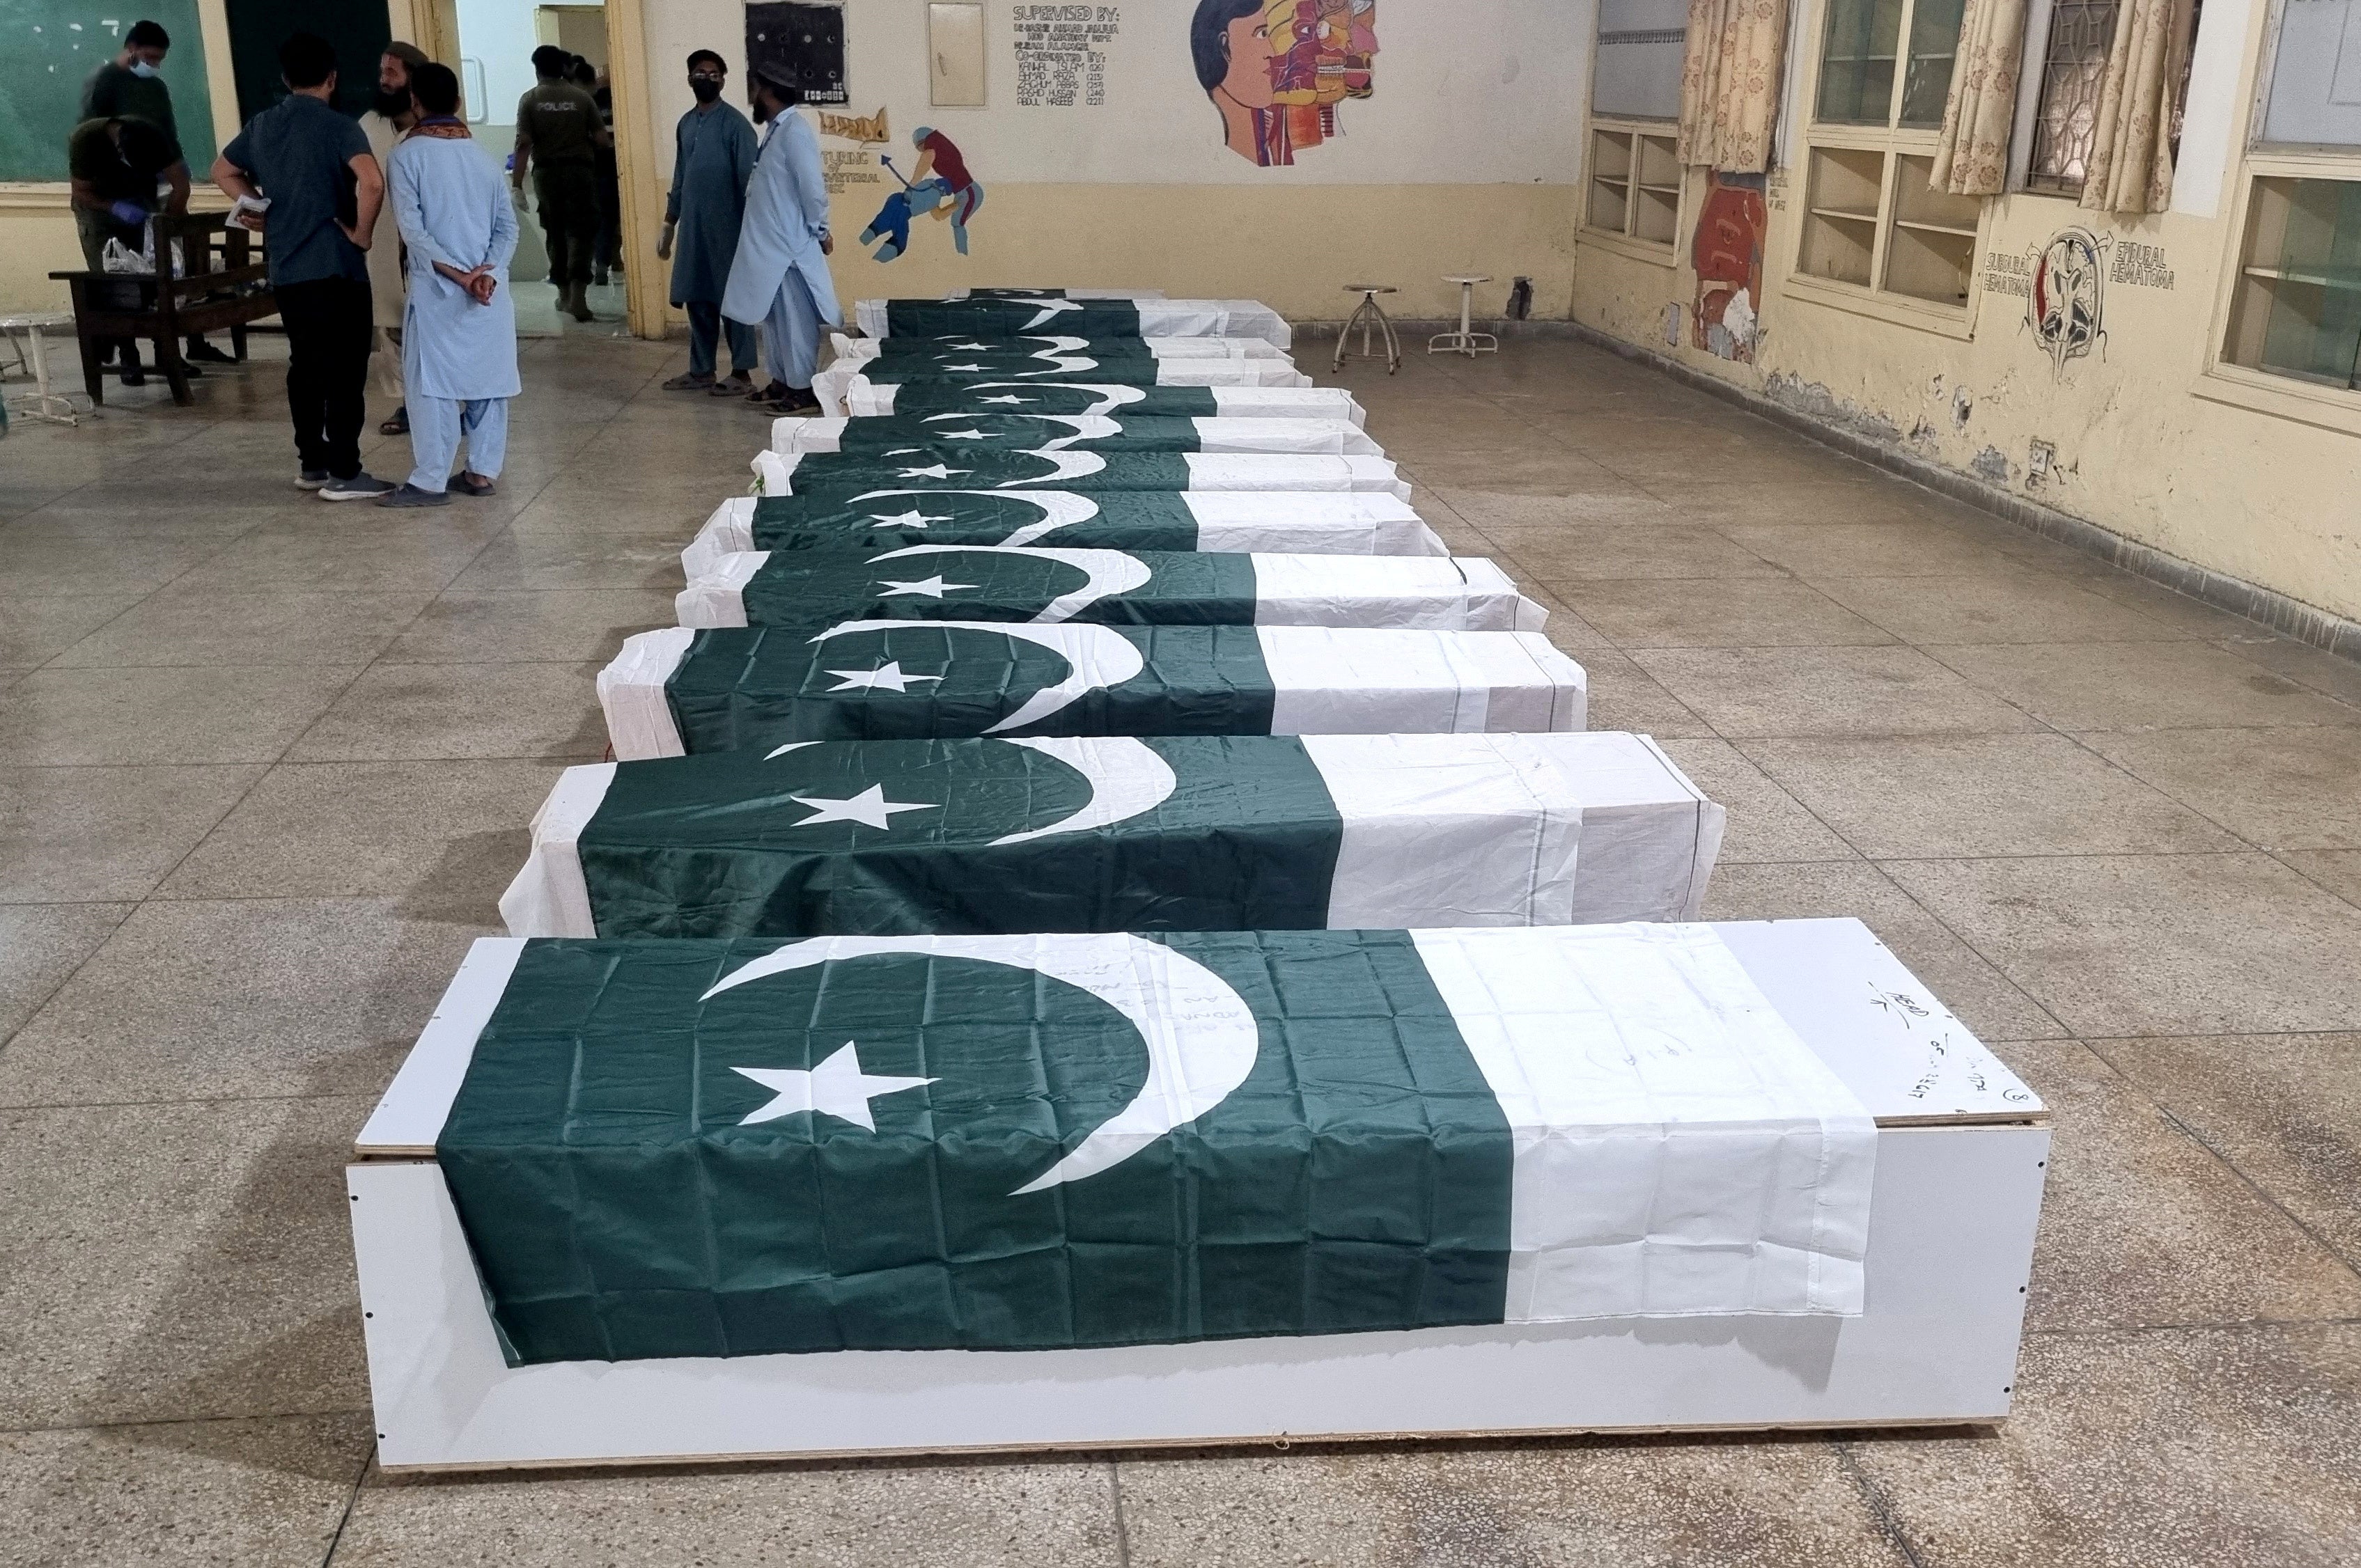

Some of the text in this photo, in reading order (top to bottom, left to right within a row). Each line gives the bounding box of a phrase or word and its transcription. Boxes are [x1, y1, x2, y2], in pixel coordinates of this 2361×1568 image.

[1013, 6, 1120, 22] SUPERVISED BY:
[1018, 61, 1050, 71] KANWAL
[1057, 61, 1085, 72] ISLAM
[1018, 70, 1046, 80] AHMAD
[1053, 71, 1075, 81] RAZA
[1017, 79, 1052, 89] ZAGHUM
[1057, 80, 1080, 89] ABBAS
[535, 101, 577, 111] POLICE
[1017, 97, 1041, 106] ABDUL
[1046, 97, 1074, 107] HASEEB
[2116, 241, 2167, 269] EPIDURAL
[1986, 252, 2031, 276] SUBDURAL
[2109, 262, 2174, 290] HEMATOMA
[1984, 273, 2029, 298] HEMATOMA
